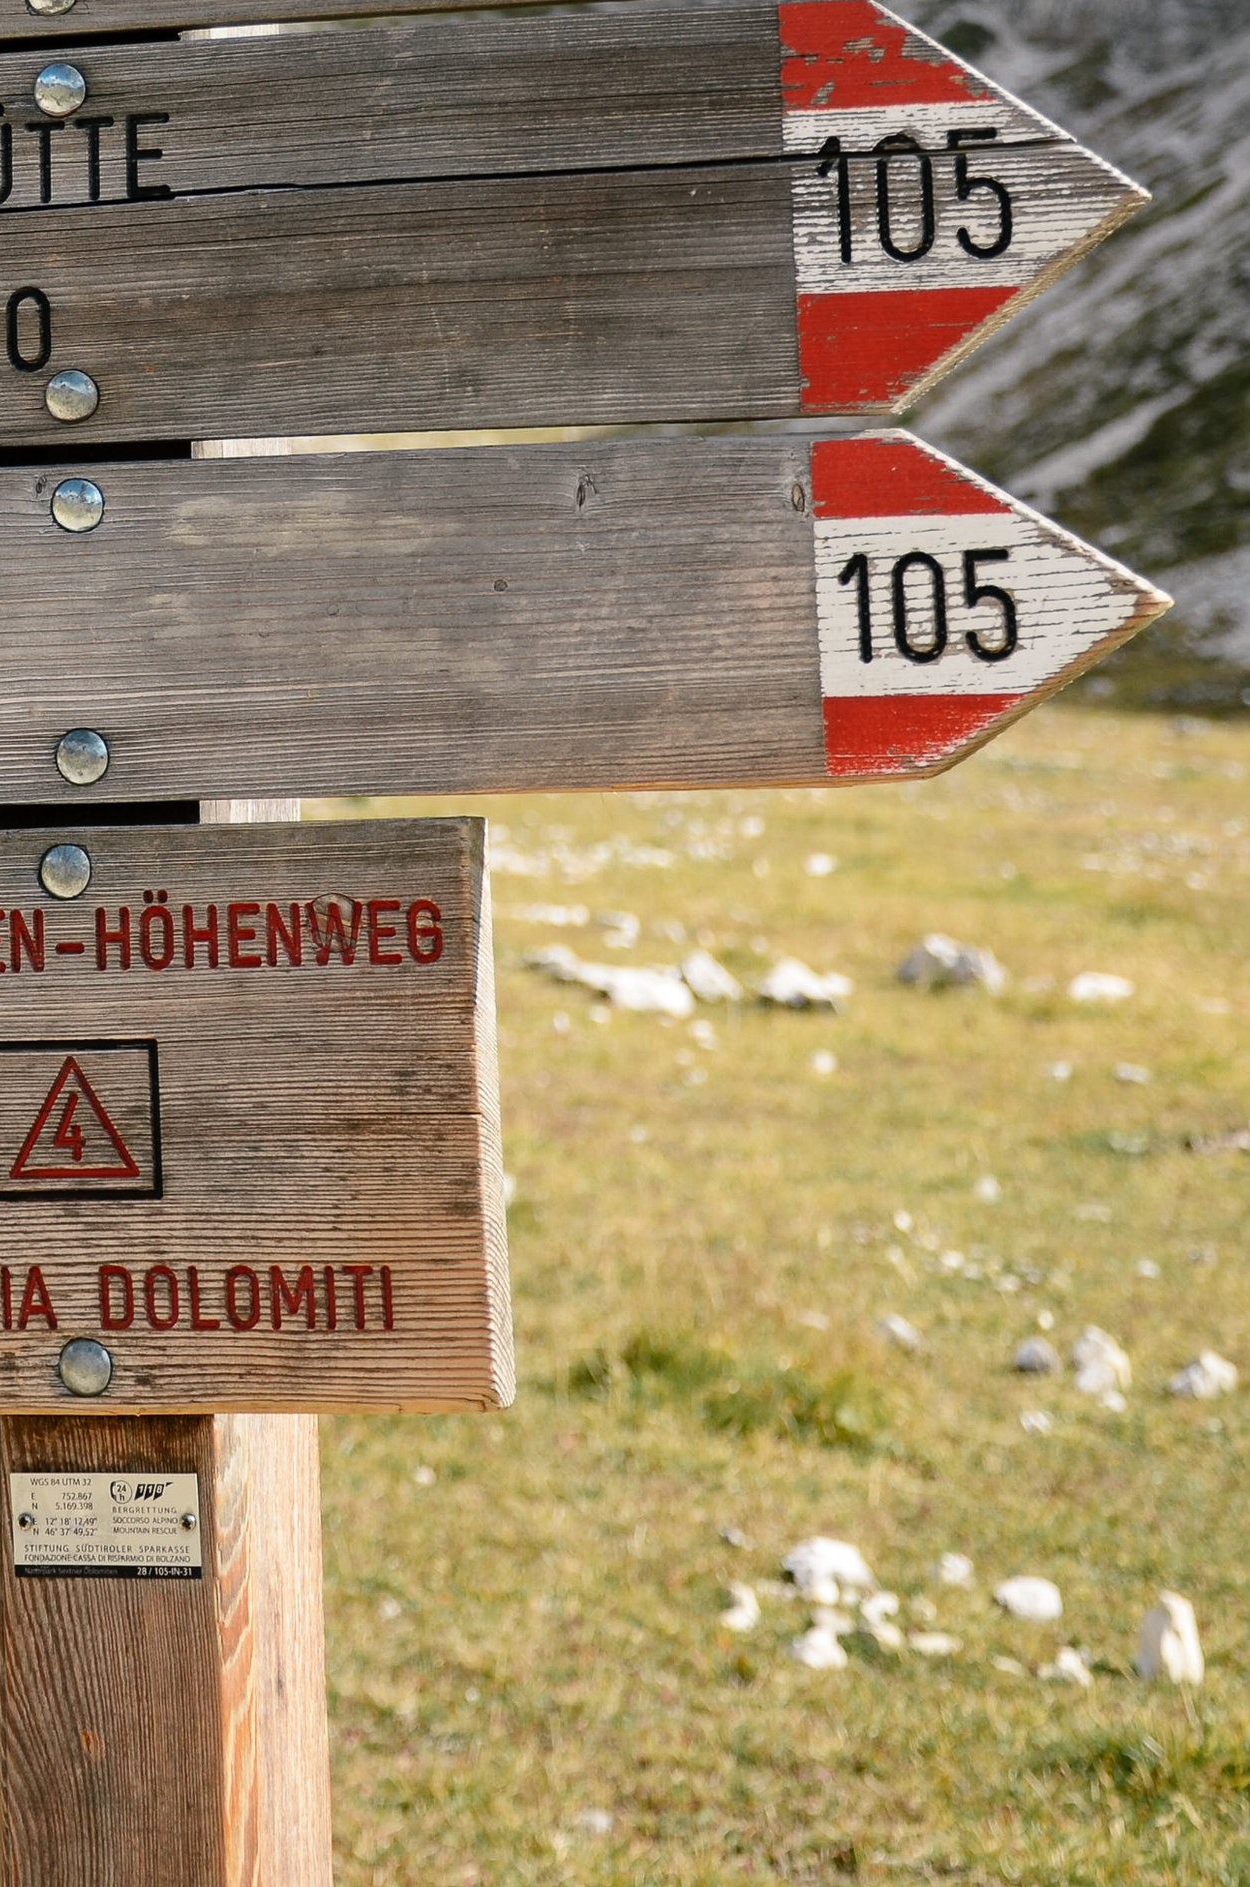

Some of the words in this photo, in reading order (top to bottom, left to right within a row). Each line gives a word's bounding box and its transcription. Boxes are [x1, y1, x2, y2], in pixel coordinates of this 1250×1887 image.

[815, 127, 1013, 265] 105
[838, 548, 1017, 665] 105
[53, 1092, 82, 1162] 4
[97, 1264, 394, 1333] DOLOMITI
[30, 1478, 49, 1486] WGS
[51, 1478, 61, 1486] 84
[62, 1478, 81, 1486] UTM
[82, 1478, 91, 1486] 32
[117, 1485, 127, 1493] 24
[32, 1502, 38, 1510] N
[113, 1516, 149, 1524] SOCCORSO
[76, 1543, 132, 1553] SÜDTIROLER
[139, 1545, 190, 1553] SPARKASSE
[156, 1555, 190, 1563] BOLZANO
[137, 1567, 147, 1575] 28
[155, 1567, 192, 1576] 105-IN-31
